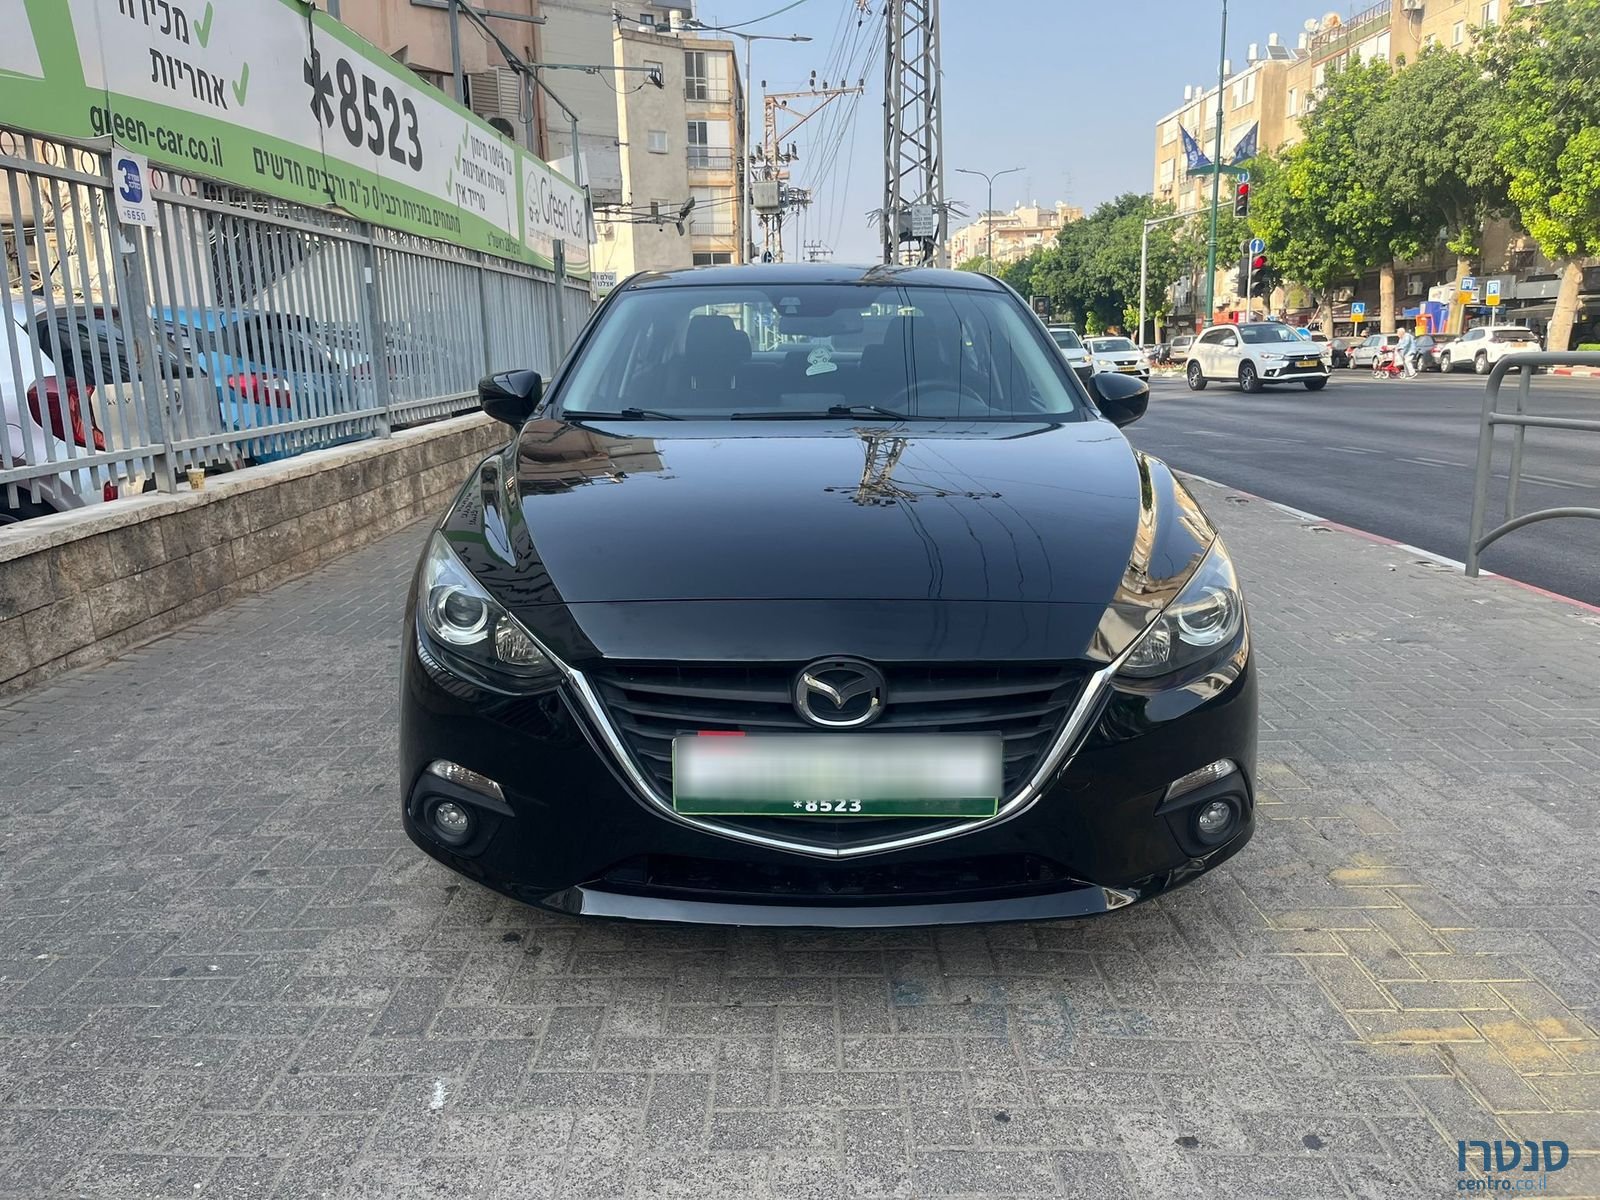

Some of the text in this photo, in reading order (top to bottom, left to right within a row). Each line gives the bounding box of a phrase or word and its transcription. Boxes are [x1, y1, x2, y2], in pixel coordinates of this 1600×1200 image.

[149, 47, 228, 110] אחריות
[90, 105, 223, 168] green-car.co.il
[252, 146, 305, 187] חדשים
[540, 176, 584, 239] Green Car
